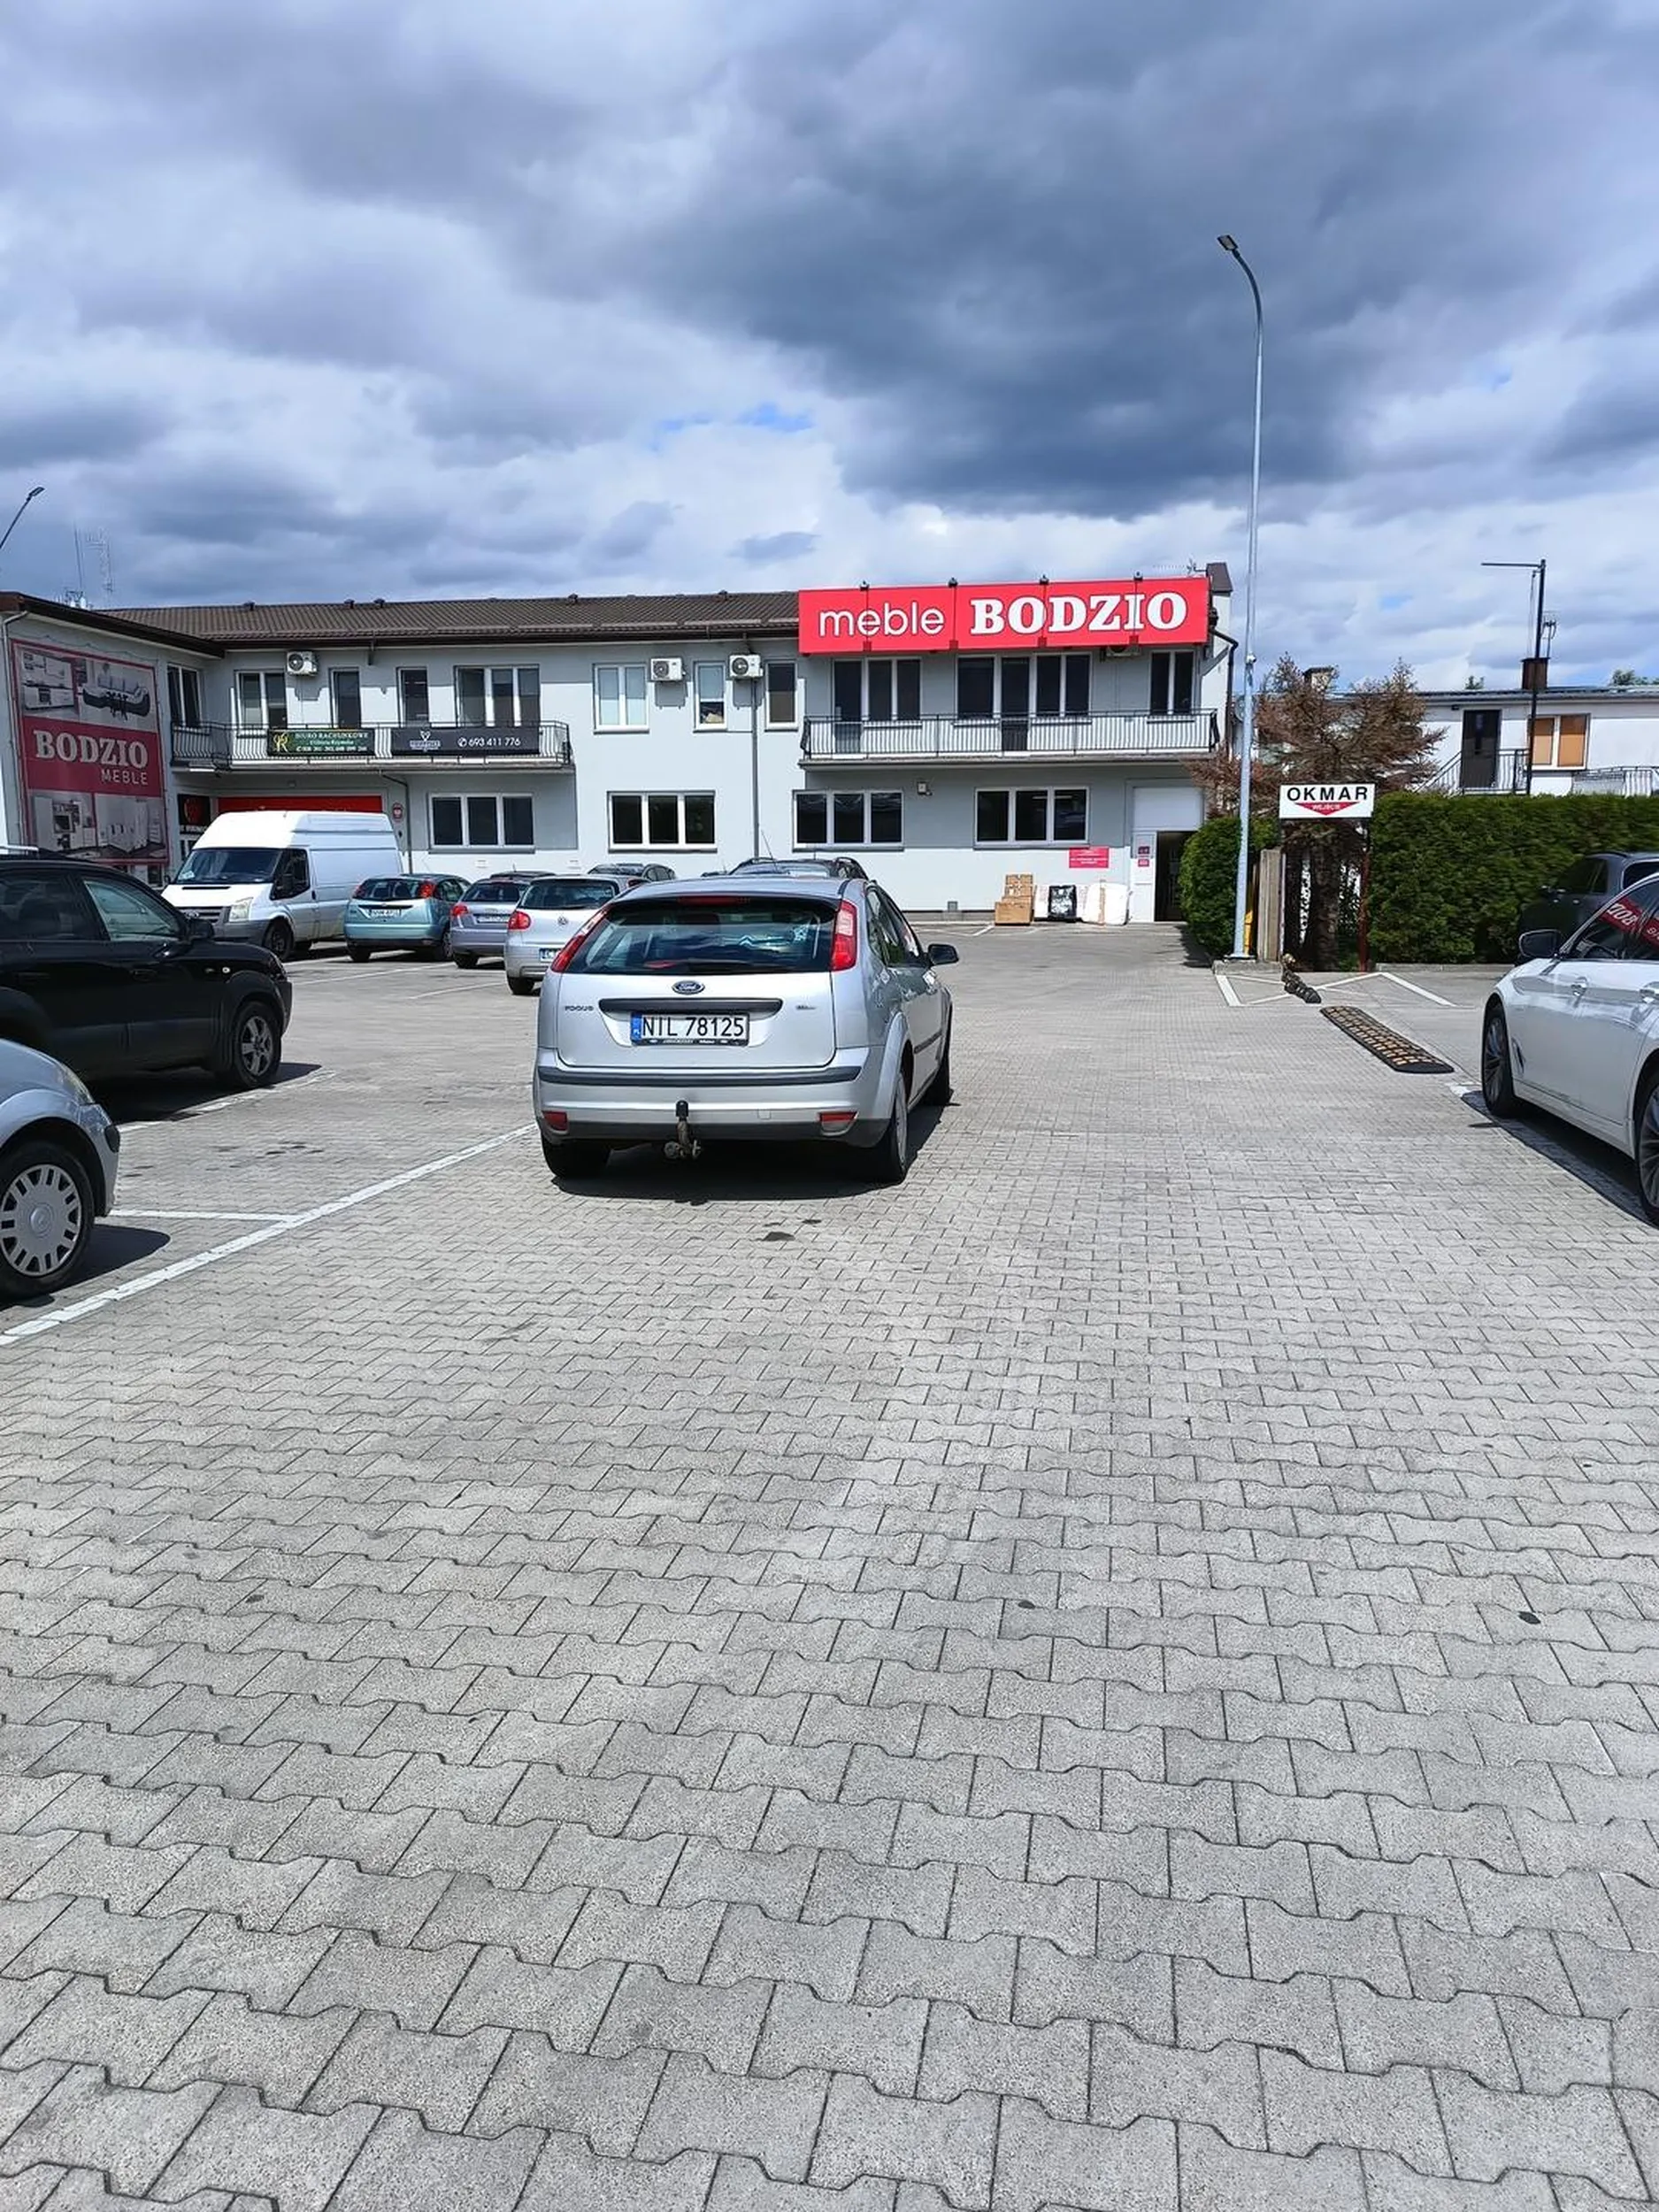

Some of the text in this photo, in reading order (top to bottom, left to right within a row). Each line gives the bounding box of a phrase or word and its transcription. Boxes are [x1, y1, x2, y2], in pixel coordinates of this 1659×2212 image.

[818, 591, 1188, 637] meble BODZIO
[33, 729, 149, 770] BODZIO
[468, 736, 521, 747] 693 411 776
[101, 767, 149, 786] MEBLE
[1286, 786, 1368, 802] OKMAR
[642, 1016, 744, 1037] NIL 78125
